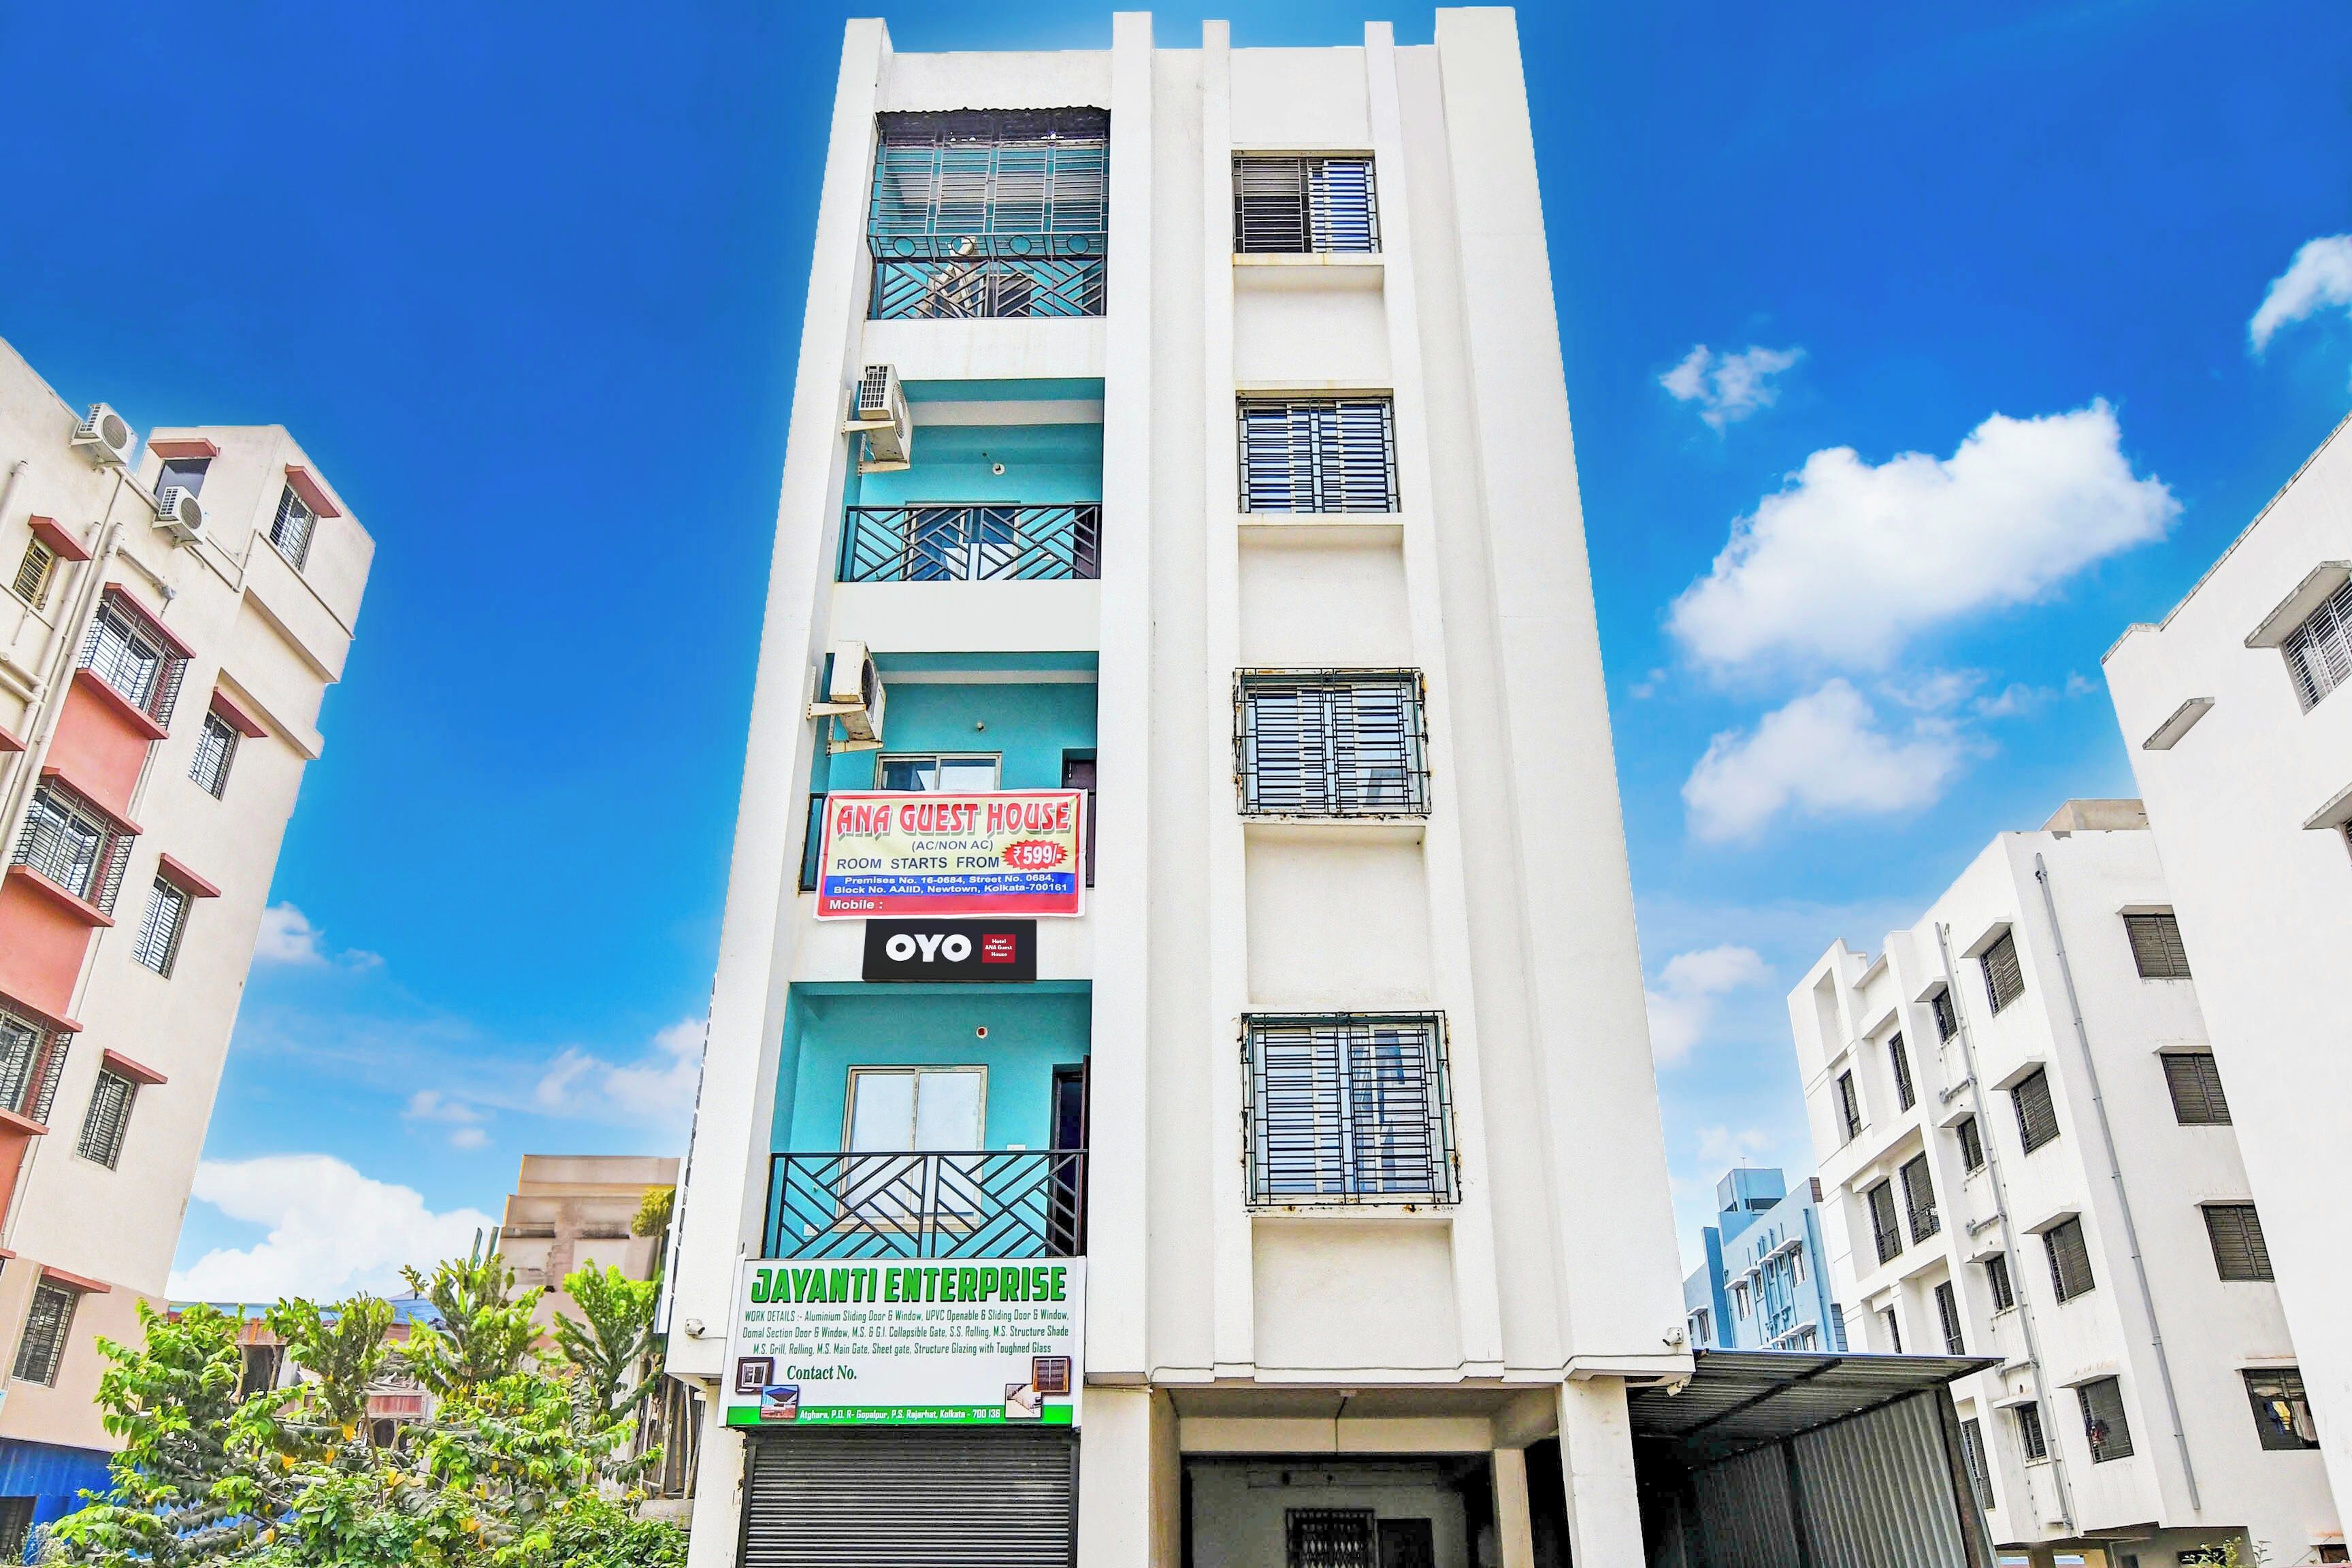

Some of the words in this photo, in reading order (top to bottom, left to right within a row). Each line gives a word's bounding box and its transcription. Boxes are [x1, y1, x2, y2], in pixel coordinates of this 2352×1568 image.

[836, 803, 892, 838] ANA
[900, 802, 982, 836] GUEST
[987, 801, 1071, 838] HOUSE
[912, 841, 967, 852] (AC/NON
[970, 840, 994, 851] AC)
[837, 858, 882, 870] ROOM
[891, 857, 947, 869] STARTS
[957, 856, 1000, 868] FROM
[844, 876, 896, 884] Premises
[898, 876, 917, 884] No.
[921, 875, 965, 885] 16-0684,
[969, 875, 1001, 883] Street
[1004, 875, 1022, 883] No.
[1026, 874, 1054, 883] 0684,
[834, 885, 865, 894] Block
[868, 885, 886, 894] No.
[927, 884, 981, 894] Newtown,
[985, 883, 1067, 893] Kolkata-700161
[829, 899, 875, 910] Mobile
[885, 934, 972, 962] OYO
[751, 1267, 877, 1303] JAYANTI
[884, 1266, 1067, 1303] ENTERPRISE
[745, 1310, 764, 1322] WORK
[767, 1310, 796, 1322] DETAILS
[804, 1310, 841, 1322] Aluminium
[843, 1310, 866, 1323] Sliding
[868, 1310, 885, 1321] Door
[895, 1309, 923, 1322] Window,
[926, 1309, 945, 1321] UPVC
[947, 1309, 979, 1322] Openable
[988, 1309, 1012, 1322] Sliding
[1014, 1309, 1031, 1320] Door
[1041, 1309, 1069, 1321] Window,
[742, 1327, 764, 1338] Domal
[766, 1327, 793, 1338] Section
[795, 1327, 812, 1338] Door
[821, 1326, 849, 1339] Window,
[852, 1326, 866, 1337] M.S.
[889, 1326, 927, 1339] Collapsible
[930, 1326, 947, 1338] Gate,
[949, 1326, 963, 1337] S.S.
[965, 1326, 991, 1339] Rolling,
[994, 1326, 1007, 1337] M.S.
[1010, 1325, 1045, 1337] Structure
[1047, 1325, 1068, 1336] Shade
[753, 1343, 768, 1354] M.S.
[770, 1343, 786, 1355] Grill,
[789, 1343, 815, 1356] Rolling,
[817, 1343, 832, 1354] M.S.
[834, 1343, 850, 1354] Main
[852, 1343, 870, 1355] Gate,
[872, 1343, 892, 1354] Sheet
[894, 1343, 912, 1356] gate,
[914, 1342, 949, 1354] Structure
[951, 1342, 977, 1356] Glazing
[979, 1342, 994, 1354] with
[996, 1342, 1030, 1356] Toughned
[1032, 1341, 1051, 1354] Glass
[787, 1365, 834, 1380] Contact
[836, 1365, 857, 1380] No.
[856, 1409, 889, 1420] Gopalpur,
[891, 1409, 904, 1419] P.S.
[906, 1409, 938, 1420] Rajarhat,
[940, 1409, 966, 1419] Kolkata
[973, 1409, 987, 1419] 700
[988, 1409, 1000, 1419] 136
